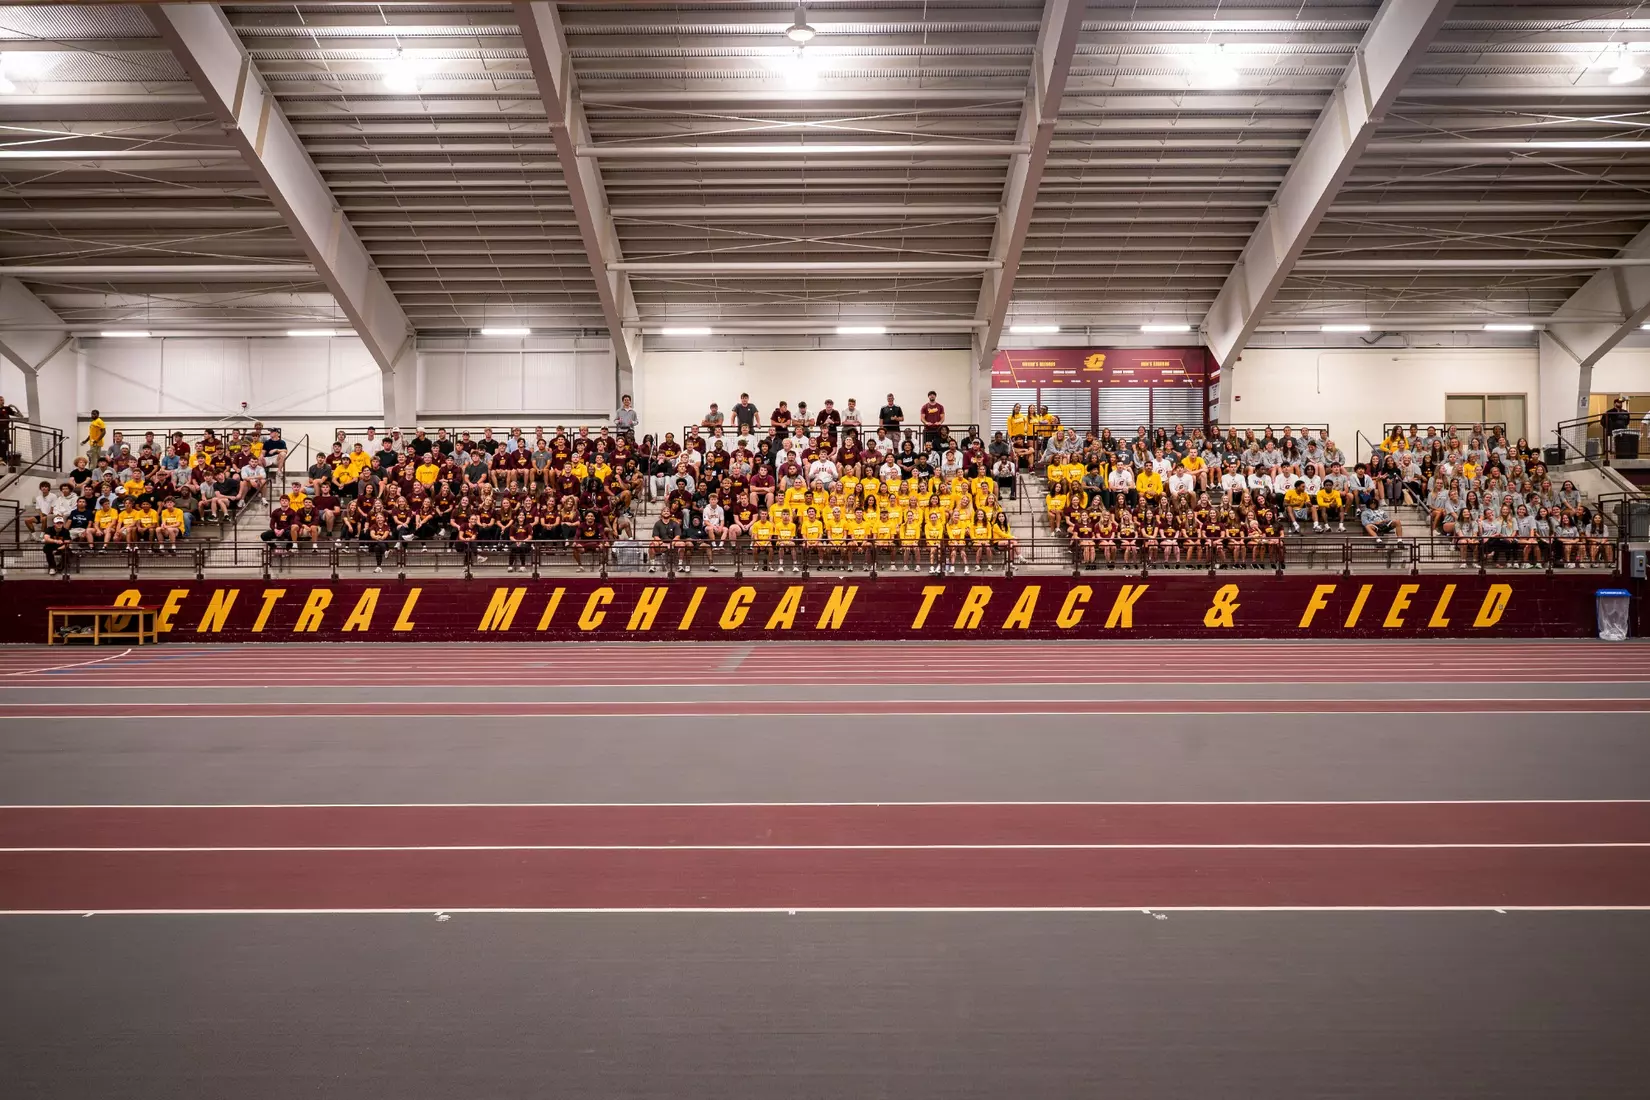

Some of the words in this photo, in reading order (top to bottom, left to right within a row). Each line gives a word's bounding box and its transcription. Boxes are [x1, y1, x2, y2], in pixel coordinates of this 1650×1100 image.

[104, 588, 421, 632] CENTRAL
[478, 586, 858, 631] MICHIGAN
[912, 585, 1148, 629] TRACK
[1204, 584, 1240, 627] &
[1299, 584, 1512, 627] FIELD
